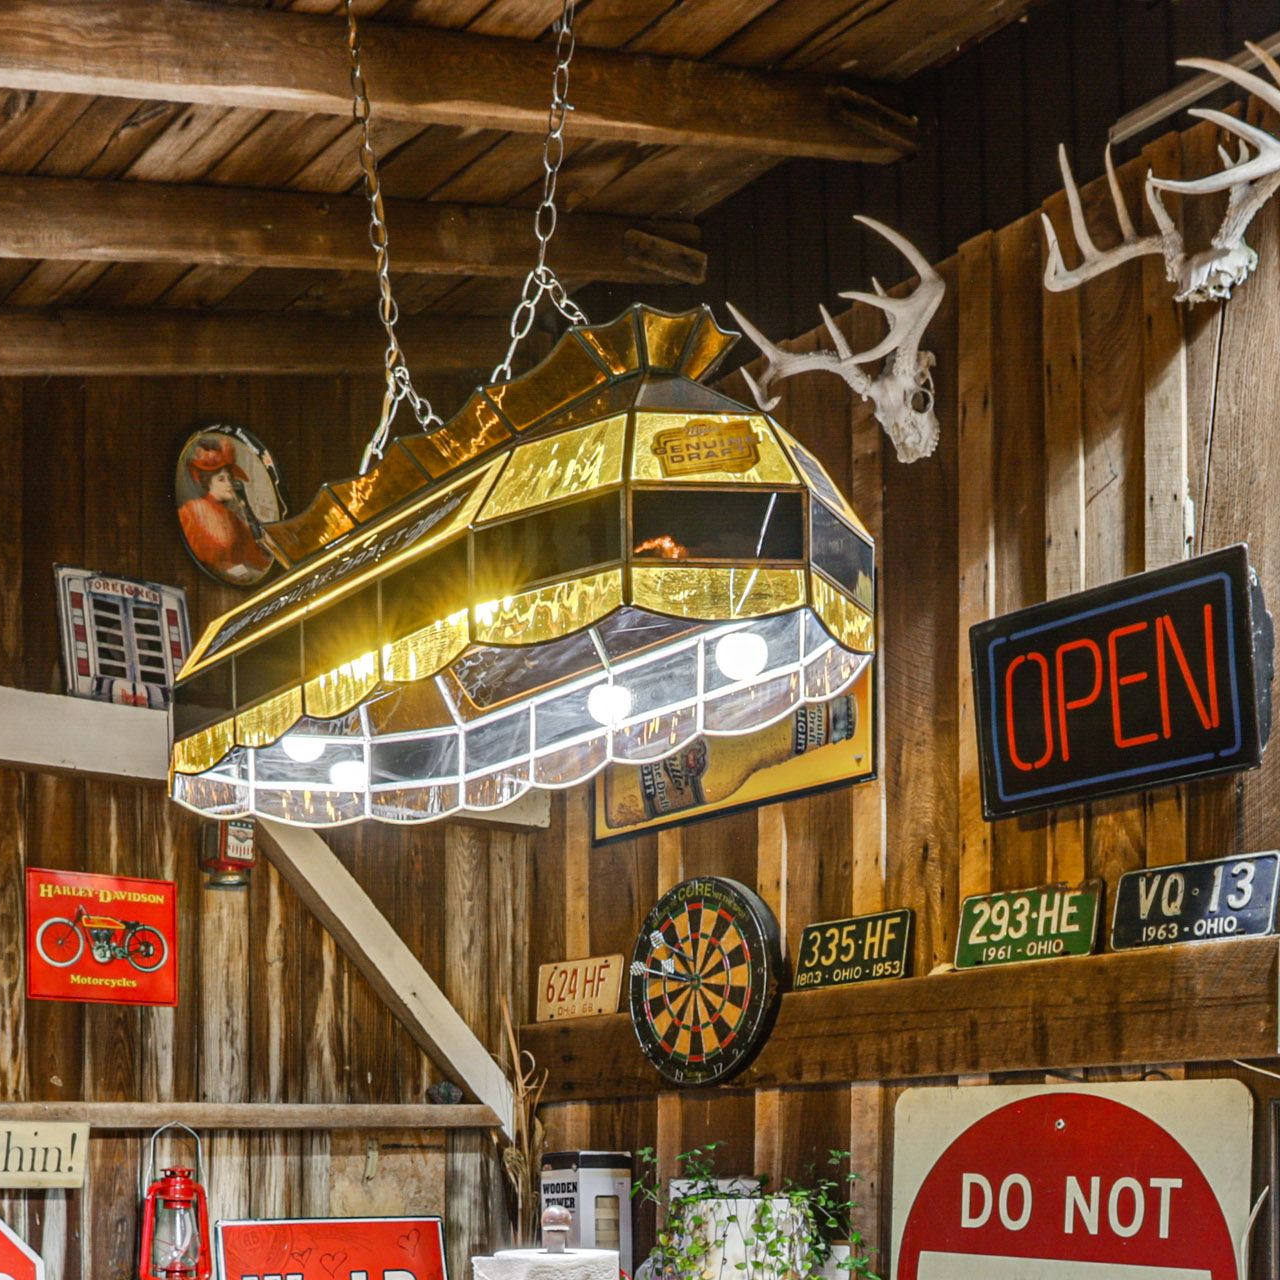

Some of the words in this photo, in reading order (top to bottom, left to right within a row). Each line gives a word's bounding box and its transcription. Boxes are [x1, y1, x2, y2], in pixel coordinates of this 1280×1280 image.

[1005, 603, 1220, 771] OPEN
[1138, 872, 1186, 920] VQ
[1208, 861, 1257, 914] 13
[1142, 922, 1179, 941] 1963
[1194, 915, 1238, 937] OHIO
[982, 945, 1012, 961] 1961
[1026, 939, 1064, 956] OHIO
[70, 974, 138, 989] Motorcycles
[546, 968, 578, 1003] 624
[583, 964, 611, 998] HF
[833, 966, 862, 982] OHIO
[872, 961, 900, 977] 1953
[543, 1182, 578, 1195] WOODEN
[961, 1172, 1033, 1232] DO
[1064, 1176, 1183, 1239] NOT
